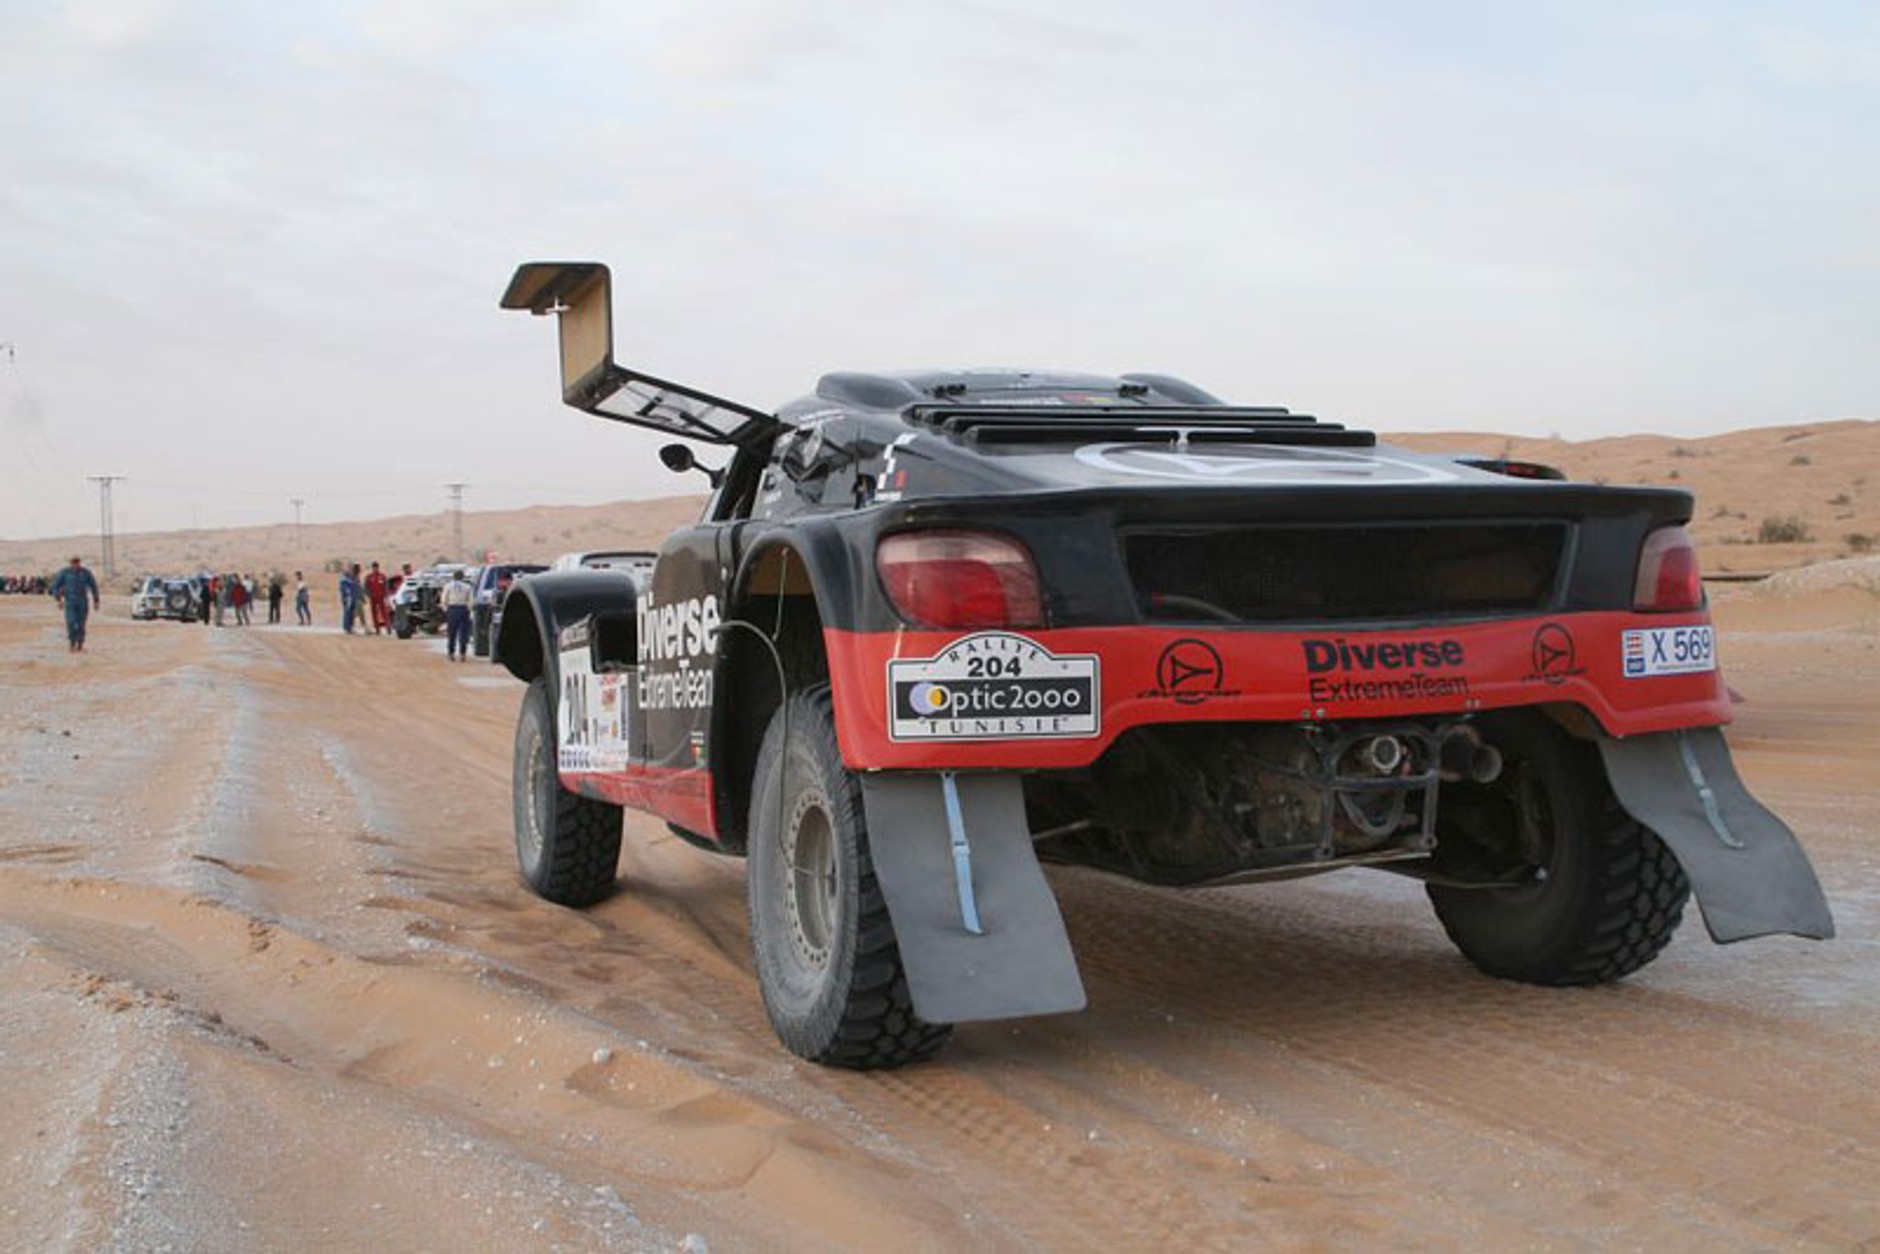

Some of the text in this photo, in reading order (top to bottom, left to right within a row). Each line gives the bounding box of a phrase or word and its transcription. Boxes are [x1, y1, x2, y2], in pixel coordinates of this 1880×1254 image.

[637, 591, 720, 661] Diverse
[1302, 638, 1464, 673] Diverse
[1651, 631, 1667, 662] X
[967, 656, 1022, 678] 204
[1309, 672, 1469, 703] ExtremeTeam
[928, 718, 1061, 734] TUNISIE
